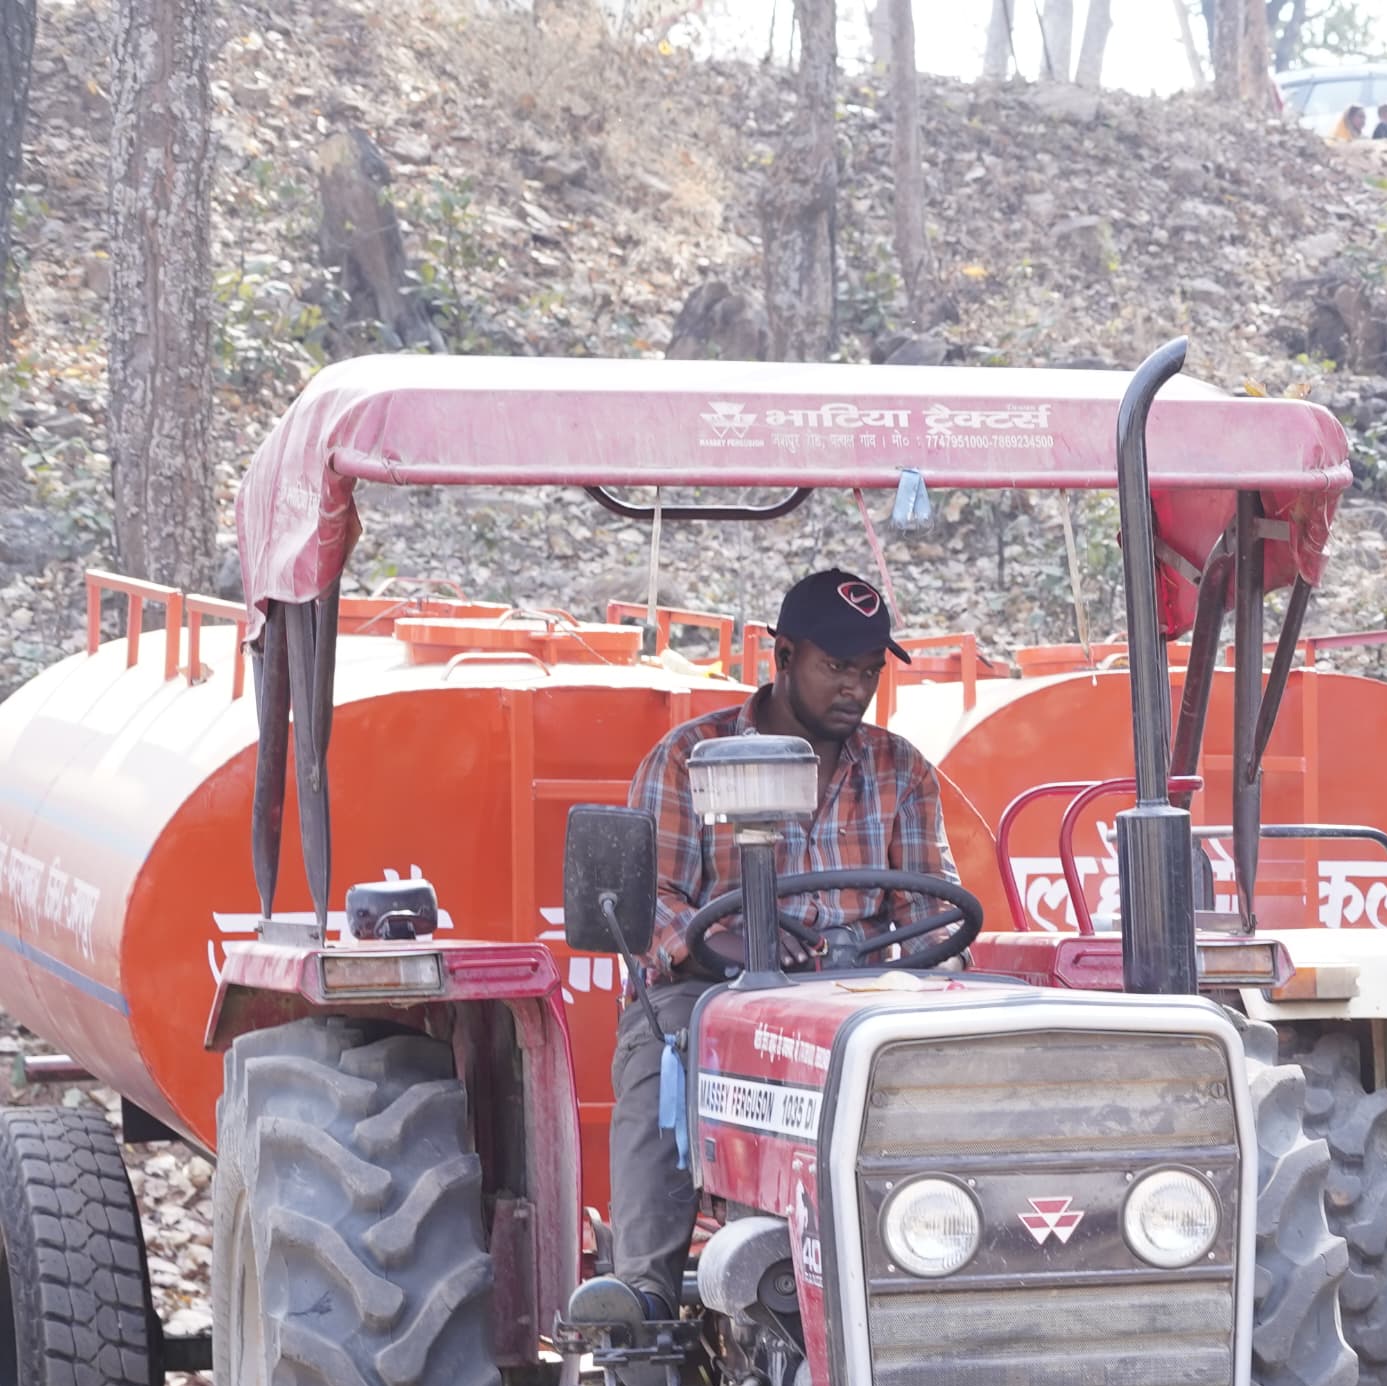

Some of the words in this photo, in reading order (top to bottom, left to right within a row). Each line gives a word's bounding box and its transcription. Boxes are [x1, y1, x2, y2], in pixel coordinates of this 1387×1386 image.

[766, 403, 911, 428] भाटिया
[701, 1079, 730, 1115] MASSEY
[731, 1084, 776, 1123] FERGUSON
[782, 1094, 805, 1129] 1035
[804, 1098, 818, 1132] DI
